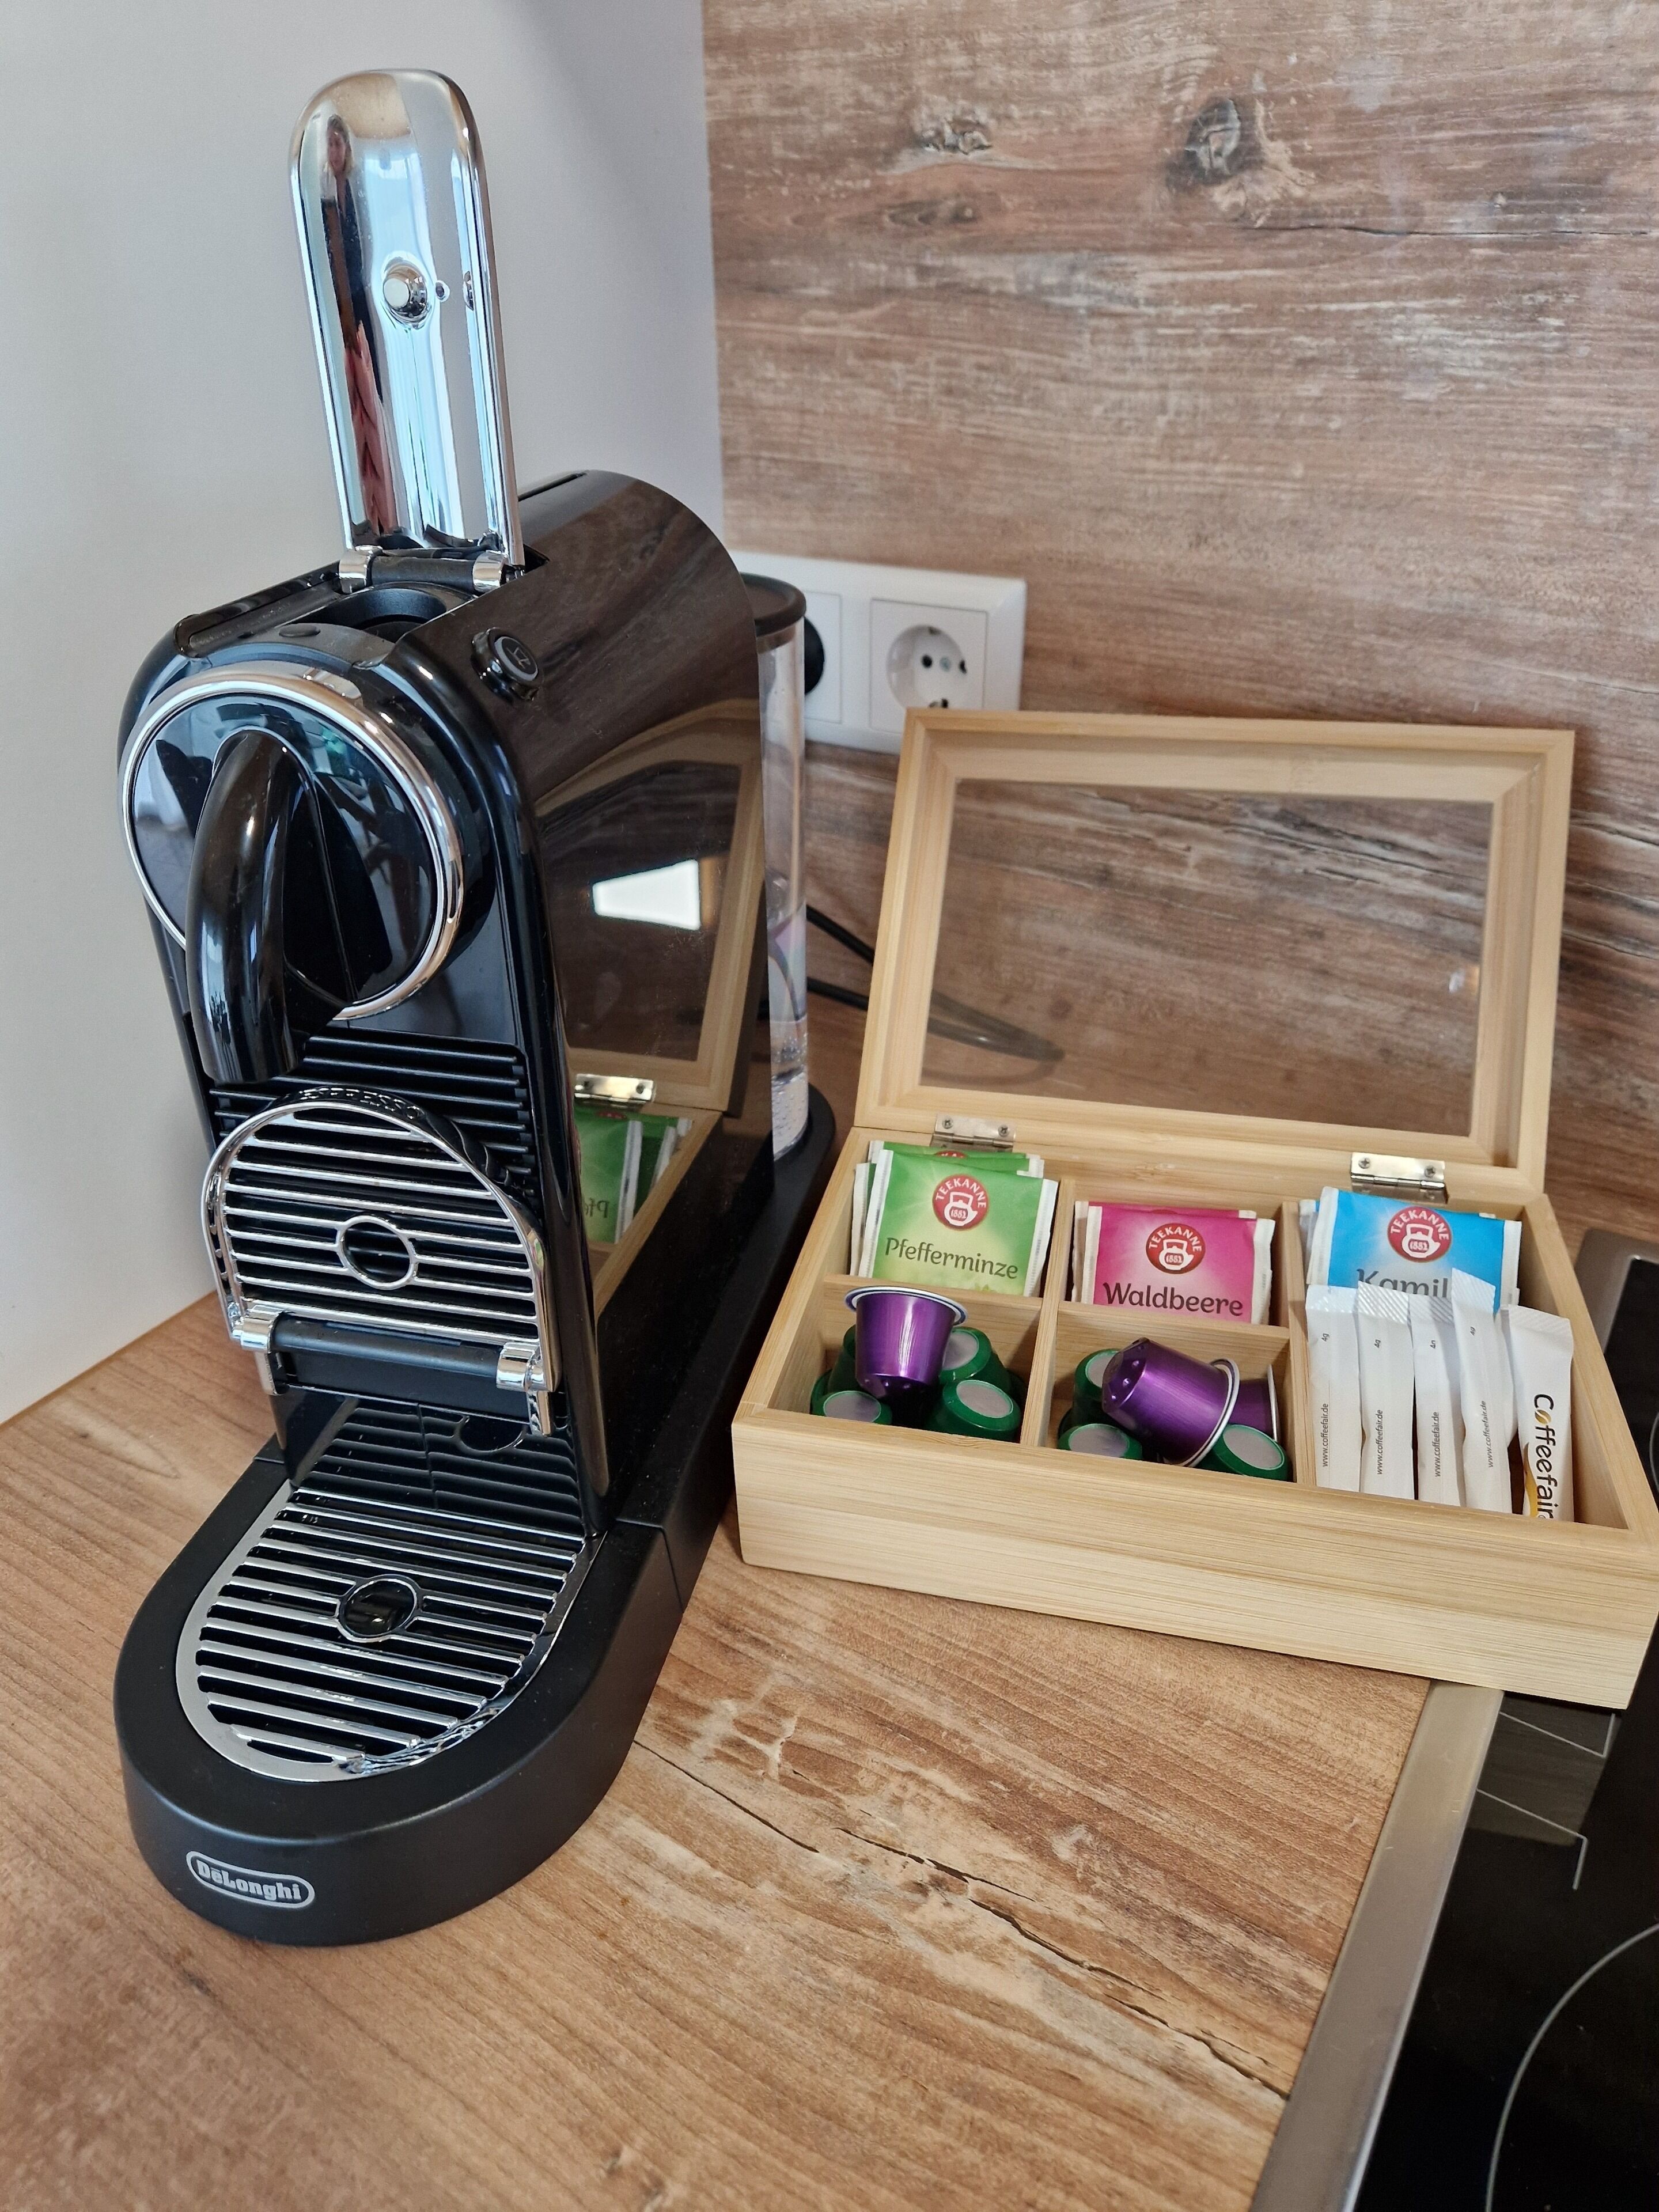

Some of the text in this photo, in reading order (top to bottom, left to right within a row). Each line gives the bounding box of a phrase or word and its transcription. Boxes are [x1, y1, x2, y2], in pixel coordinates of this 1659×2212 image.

[935, 1177, 987, 1208] TEEKANNE
[950, 1209, 967, 1219] 1882
[1390, 1210, 1449, 1240] TEEKANNE
[1149, 1226, 1202, 1252] TEEKANNE
[885, 1237, 1018, 1280] Pfefferminze
[1104, 1282, 1244, 1317] Waldbeere
[1356, 1268, 1448, 1298] Kamil
[1320, 1403, 1328, 1467] www.coffeefair.de
[1431, 1411, 1441, 1477] www.coffeefair.de
[1481, 1400, 1494, 1468] www.coffeefair.de
